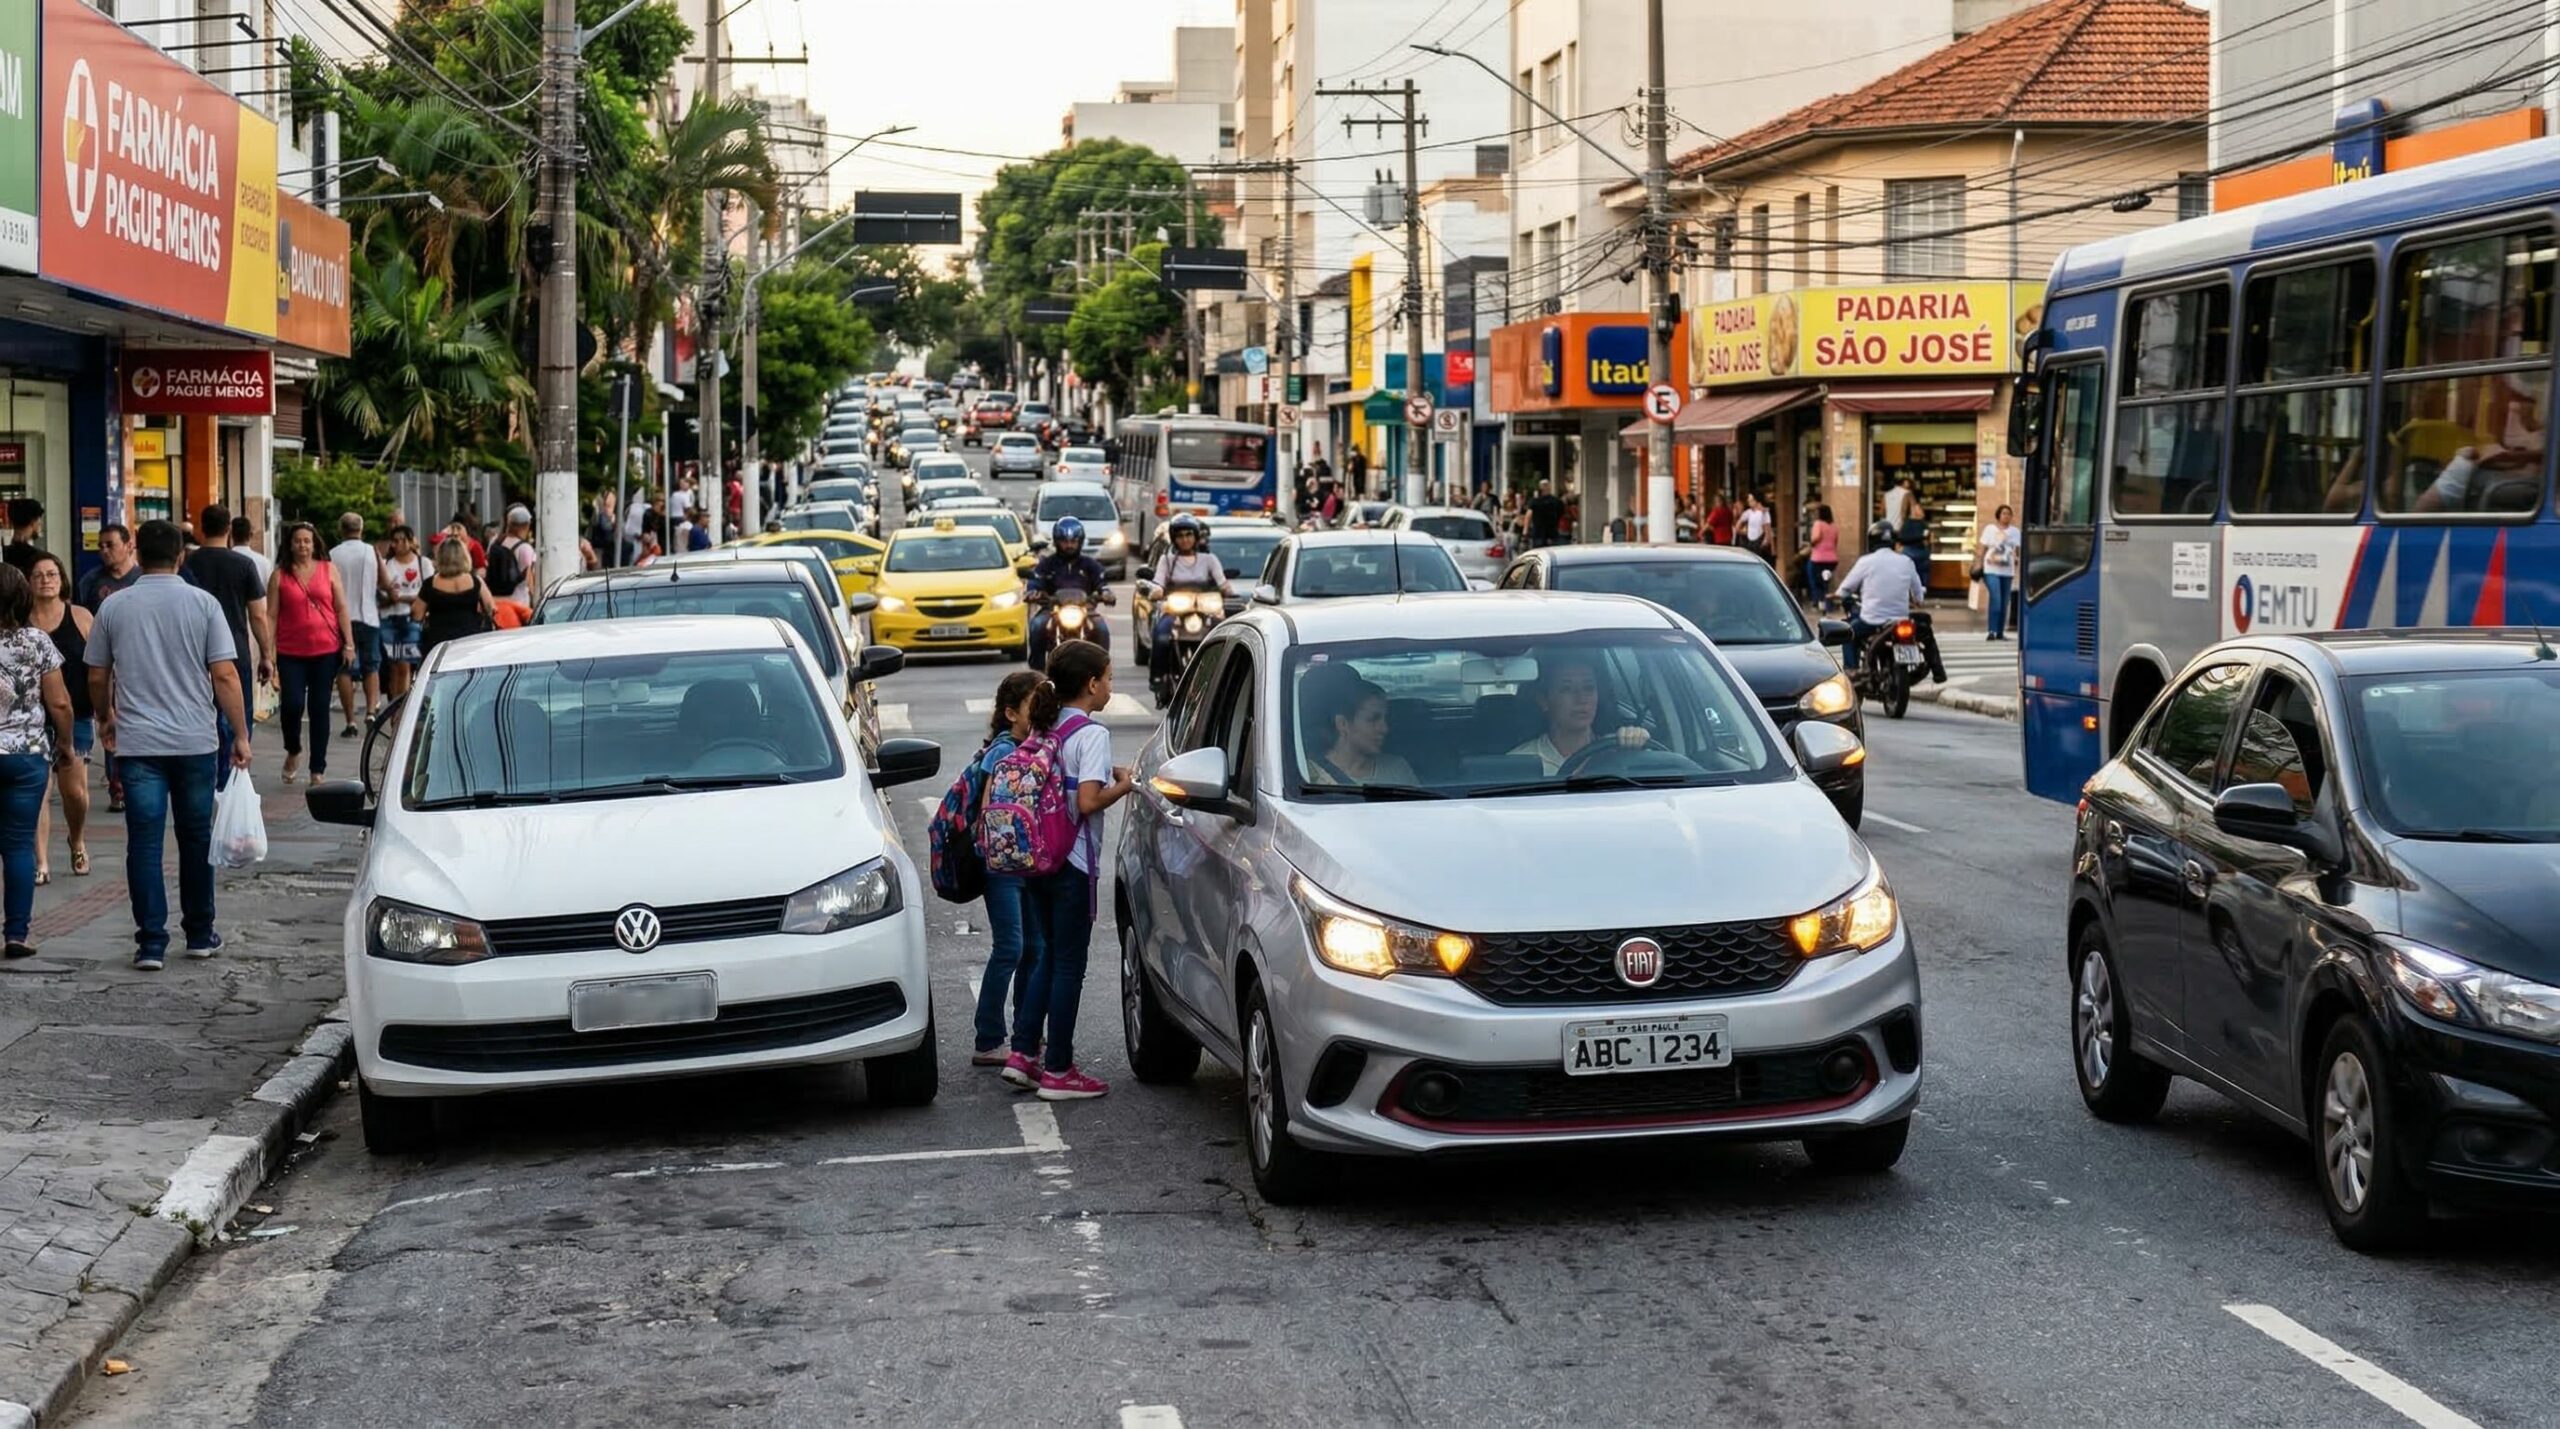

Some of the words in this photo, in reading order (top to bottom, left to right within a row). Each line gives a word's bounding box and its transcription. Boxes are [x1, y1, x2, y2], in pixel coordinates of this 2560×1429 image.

[108, 81, 219, 200] FARMÁCIA
[105, 173, 162, 252] PAGUE
[165, 197, 221, 271] MENOS
[291, 245, 325, 301] BANCO
[326, 253, 345, 309] ITAÚ
[1837, 293, 1970, 322] PADARIA
[1816, 329, 1887, 366] SÃO
[1900, 323, 1992, 364] JOSÉ
[166, 366, 263, 385] FARMÁCIA
[1591, 359, 1649, 384] Itaú
[166, 385, 212, 397] PAGUE
[215, 386, 264, 398] MENOS
[1656, 391, 1671, 414] E
[2258, 584, 2317, 628] EMTU
[1626, 951, 1654, 976] FIAT
